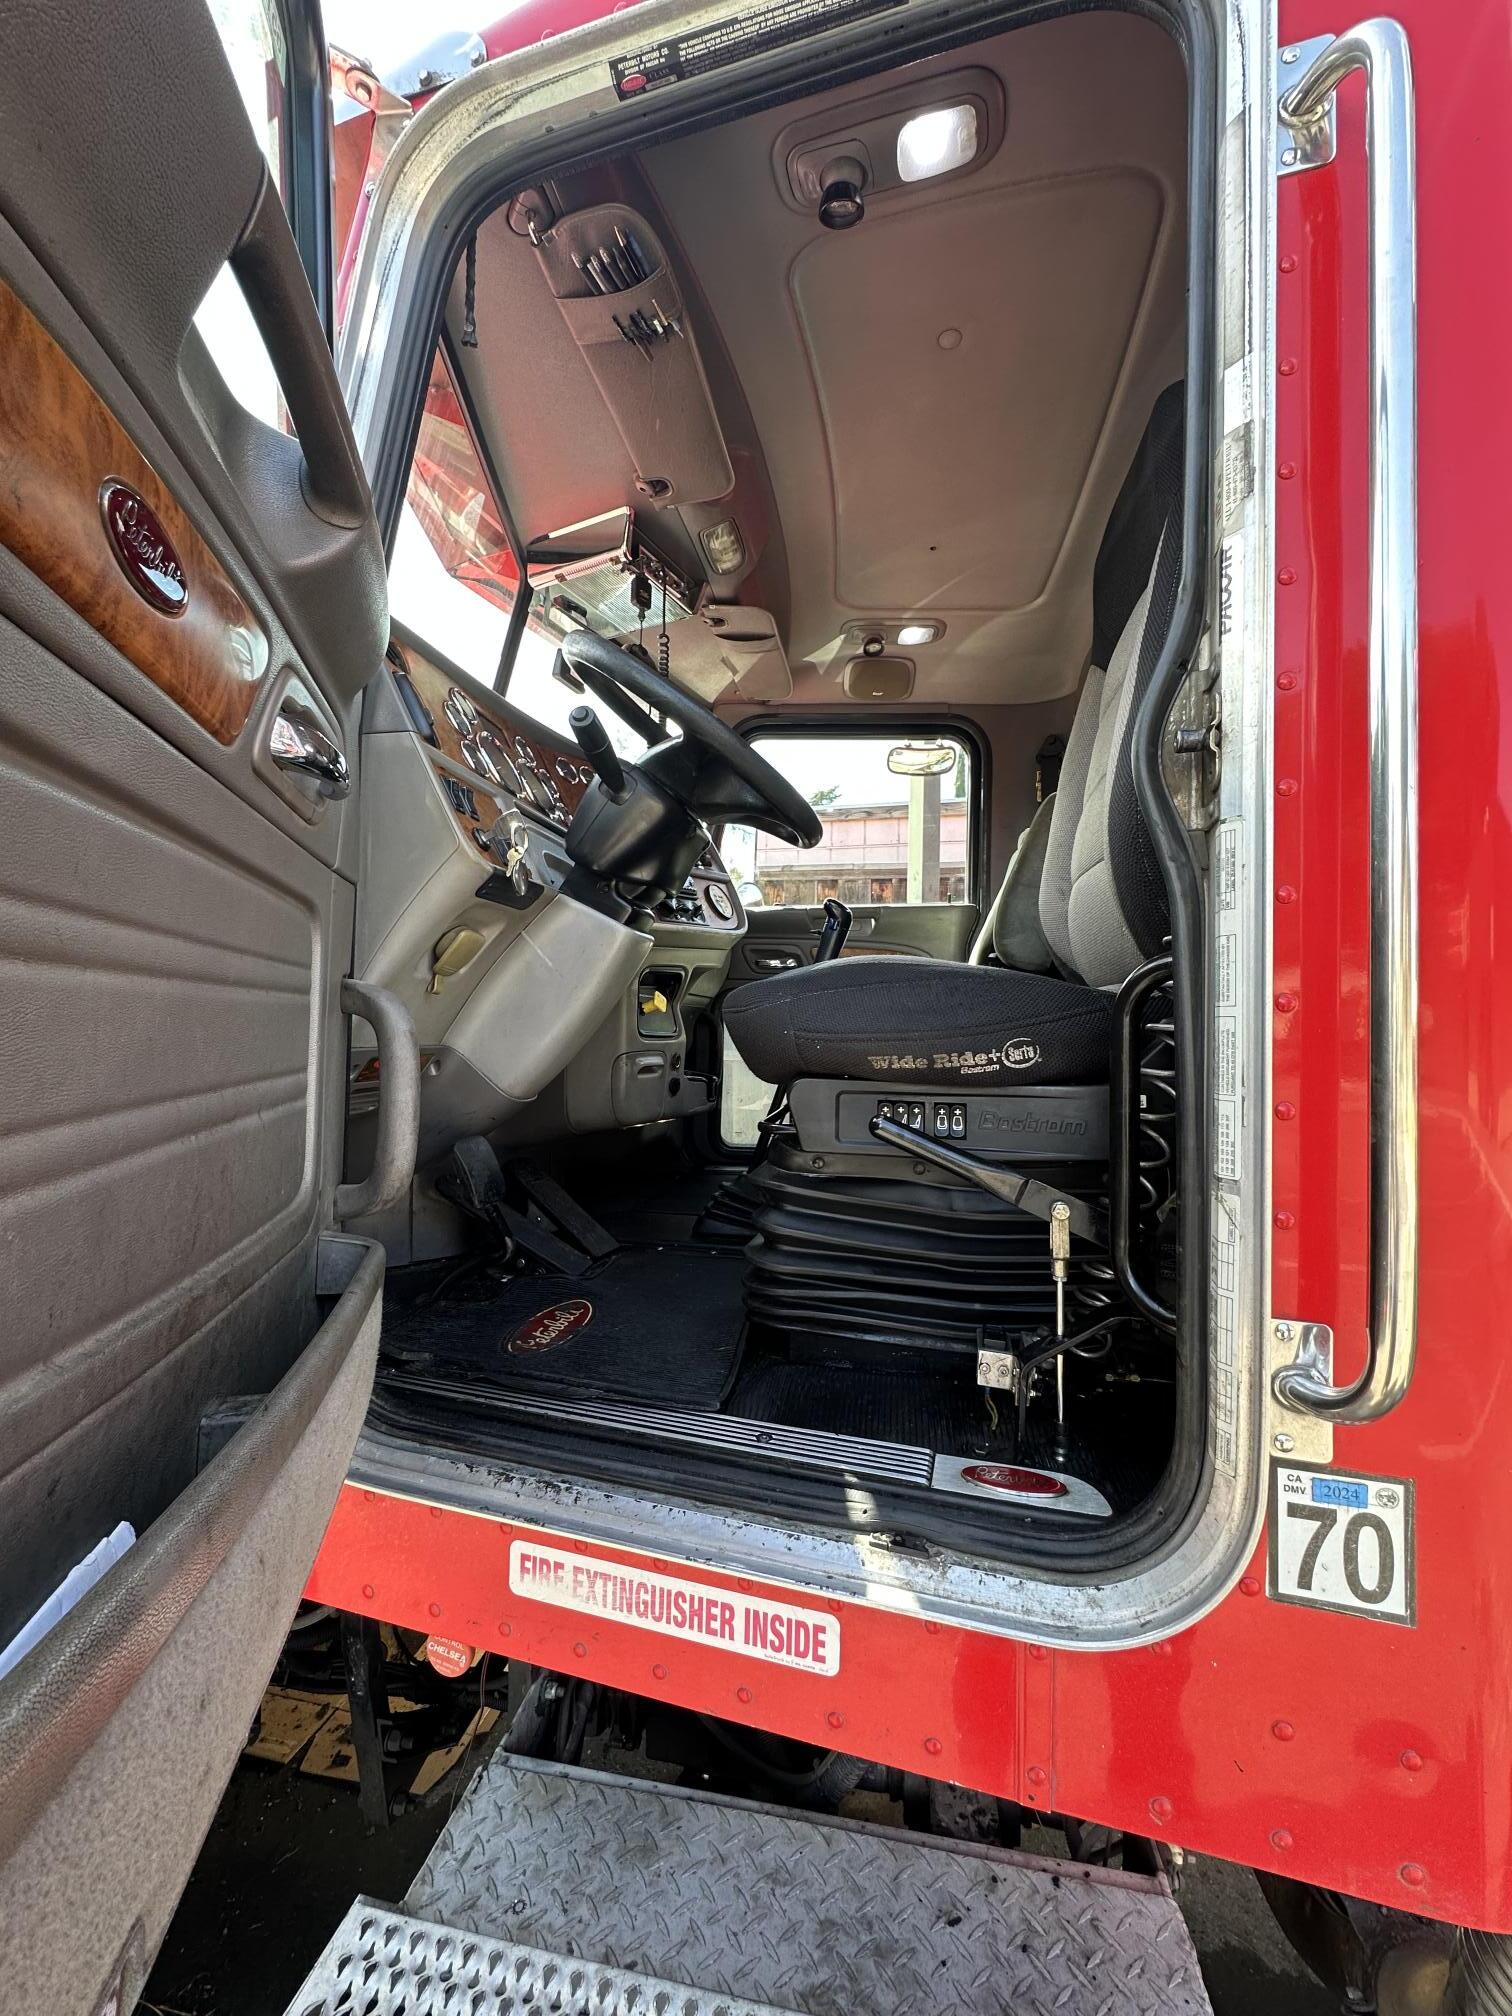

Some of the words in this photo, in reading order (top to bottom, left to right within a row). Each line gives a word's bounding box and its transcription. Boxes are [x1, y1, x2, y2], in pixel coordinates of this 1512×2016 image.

[868, 1055, 928, 1070] Wide
[1007, 1048, 1035, 1063] Serta
[960, 1064, 1000, 1074] Bostrom
[979, 1110, 1088, 1136] Bostrom
[1287, 1474, 1303, 1484] CA
[1283, 1484, 1307, 1495] DMV
[1323, 1485, 1361, 1501] 2024
[1287, 1501, 1395, 1605] 70
[519, 1552, 566, 1590] FIRE
[571, 1566, 736, 1641] EXTINGUISHER
[743, 1603, 828, 1665] INSIDE
[428, 1641, 466, 1664] CHELSEA
